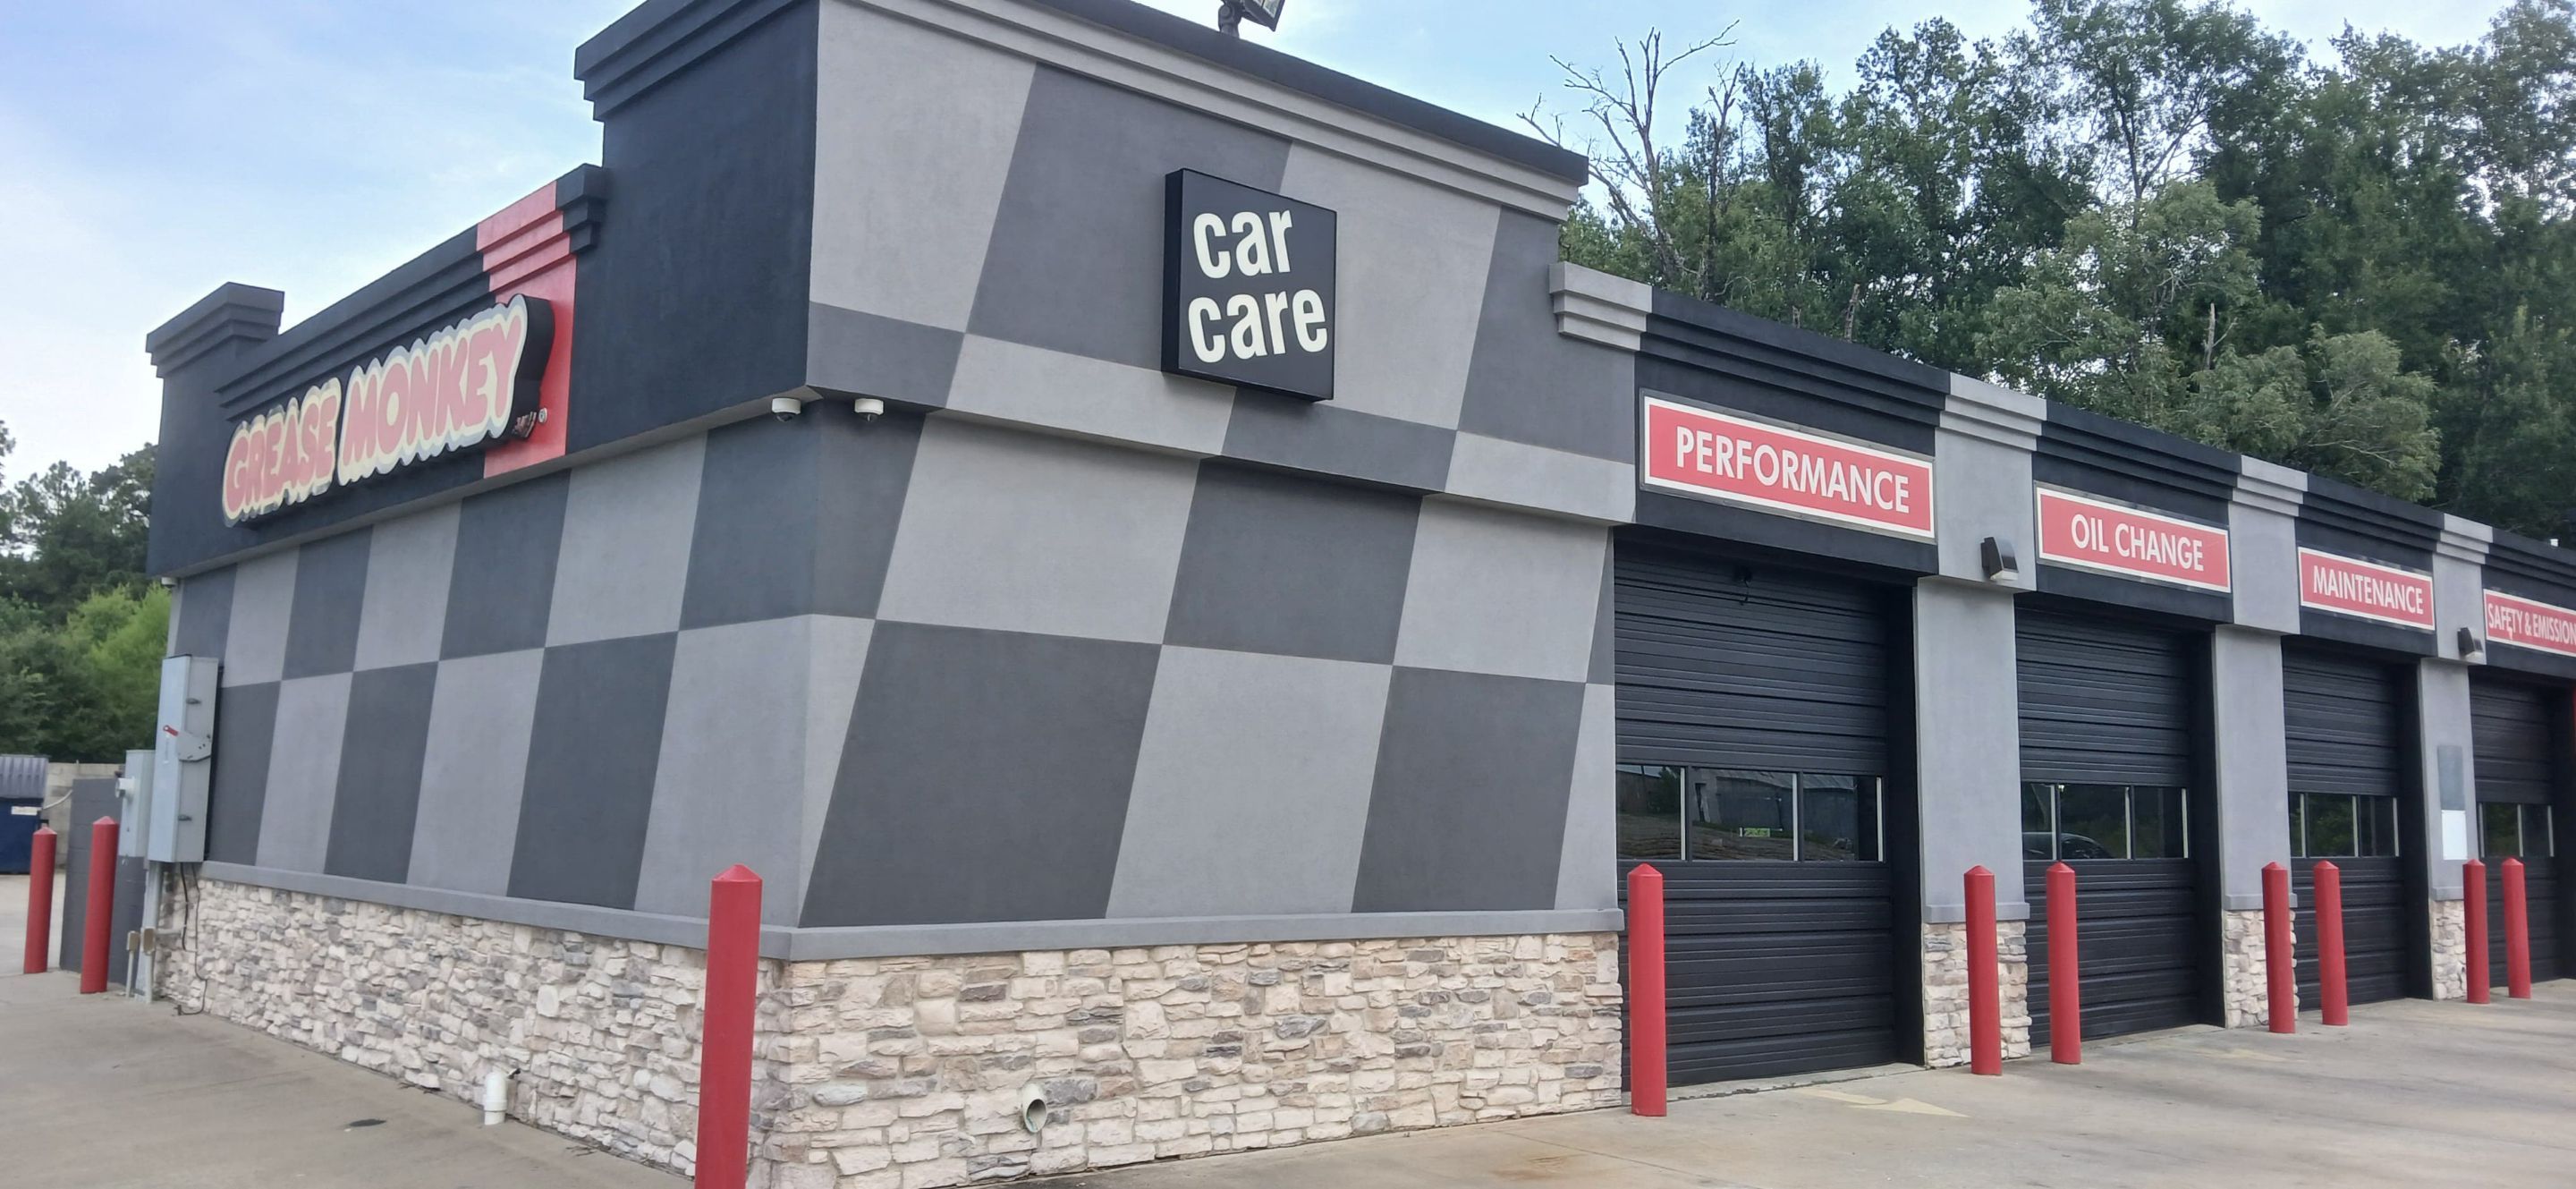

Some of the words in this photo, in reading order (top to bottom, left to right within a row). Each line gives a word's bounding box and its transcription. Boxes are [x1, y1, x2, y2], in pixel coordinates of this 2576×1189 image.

[1193, 209, 1292, 279] car
[1188, 288, 1327, 363] care
[225, 390, 338, 518] GREASE
[342, 310, 524, 471] MONKEY
[1676, 426, 1910, 514] PERFORMANCE
[2071, 514, 2109, 553] OIL
[2114, 522, 2204, 571] CHANGE
[2313, 565, 2424, 615] MAINTENANCE
[2487, 603, 2522, 634] SAFETY
[2524, 611, 2532, 636] &
